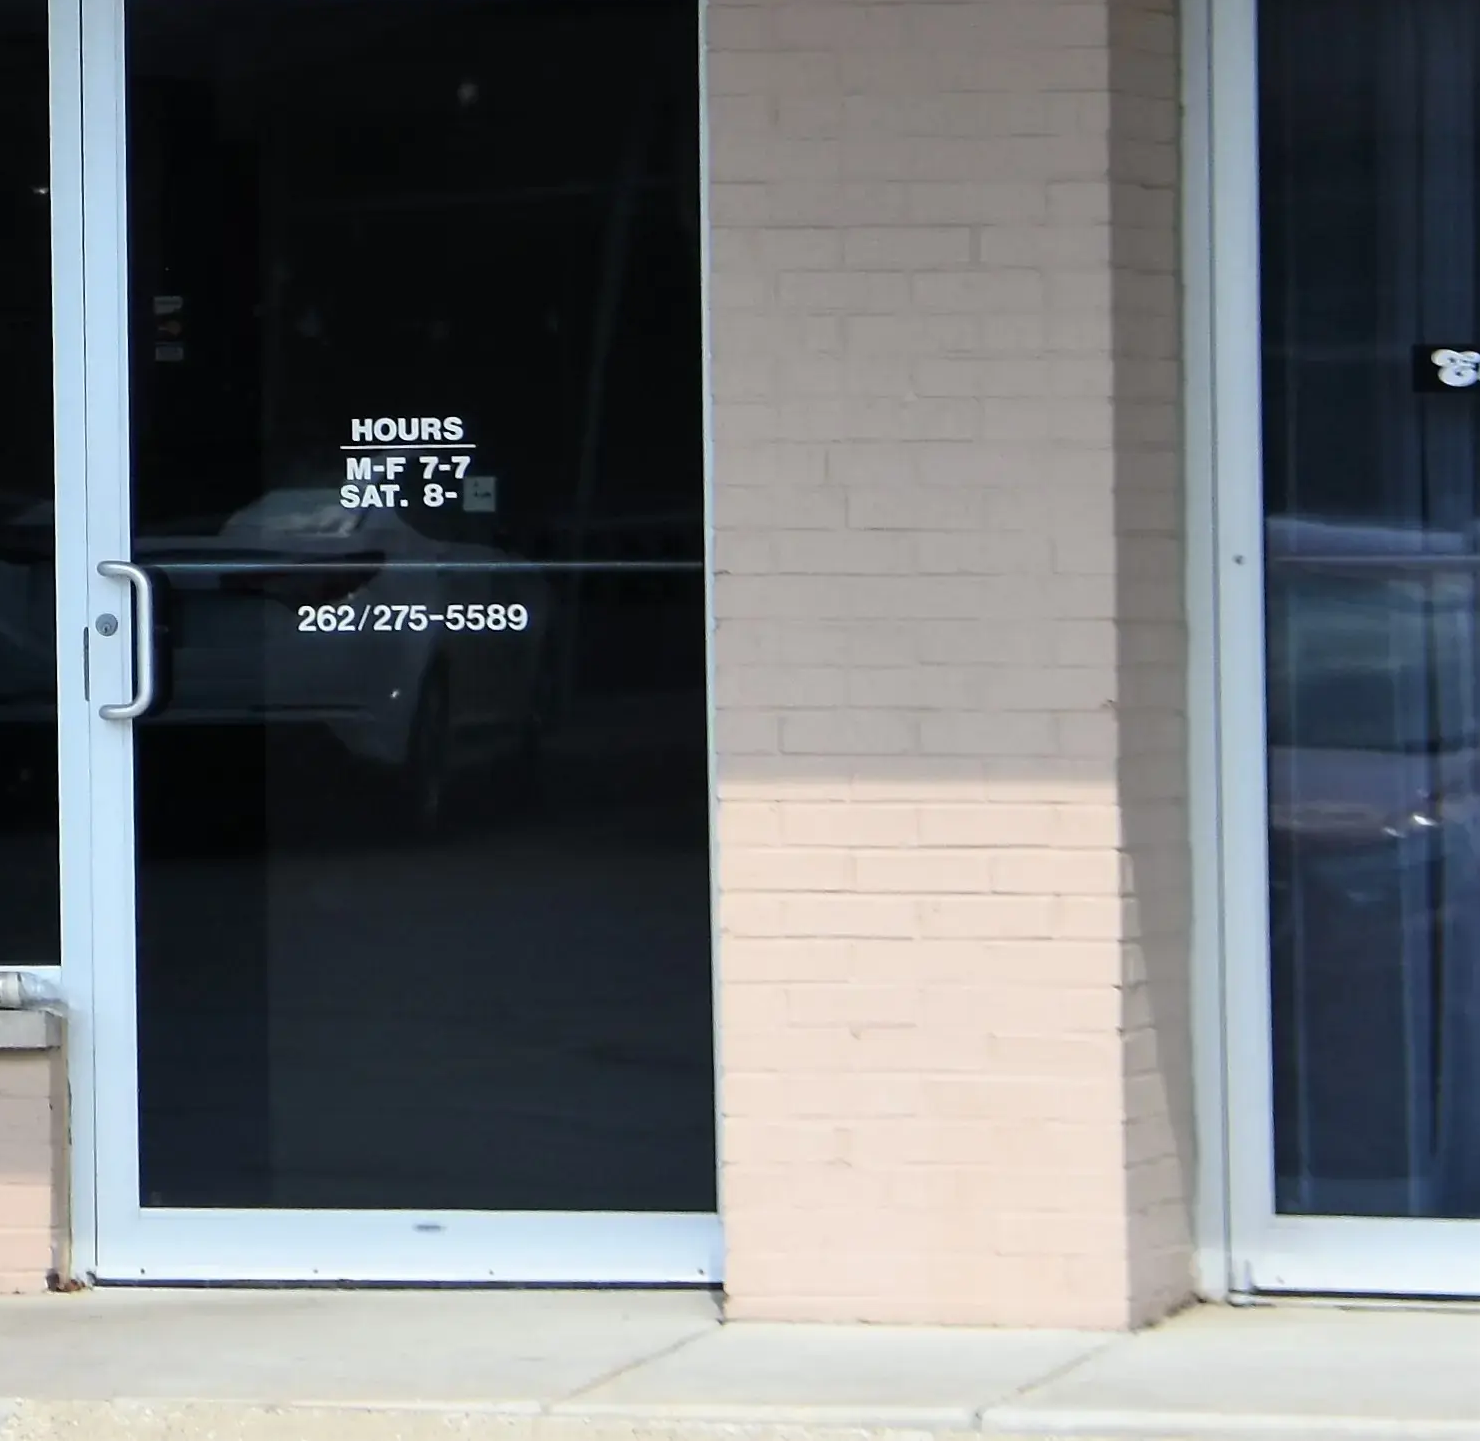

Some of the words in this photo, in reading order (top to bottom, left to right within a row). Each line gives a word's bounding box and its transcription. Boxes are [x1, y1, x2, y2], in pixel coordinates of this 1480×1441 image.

[351, 416, 464, 442] HOURS
[346, 456, 407, 481] M-F
[419, 455, 471, 480] 7-7
[339, 483, 409, 509] SAT.
[423, 483, 458, 508] 8-
[297, 603, 529, 632] 262/275-5589
